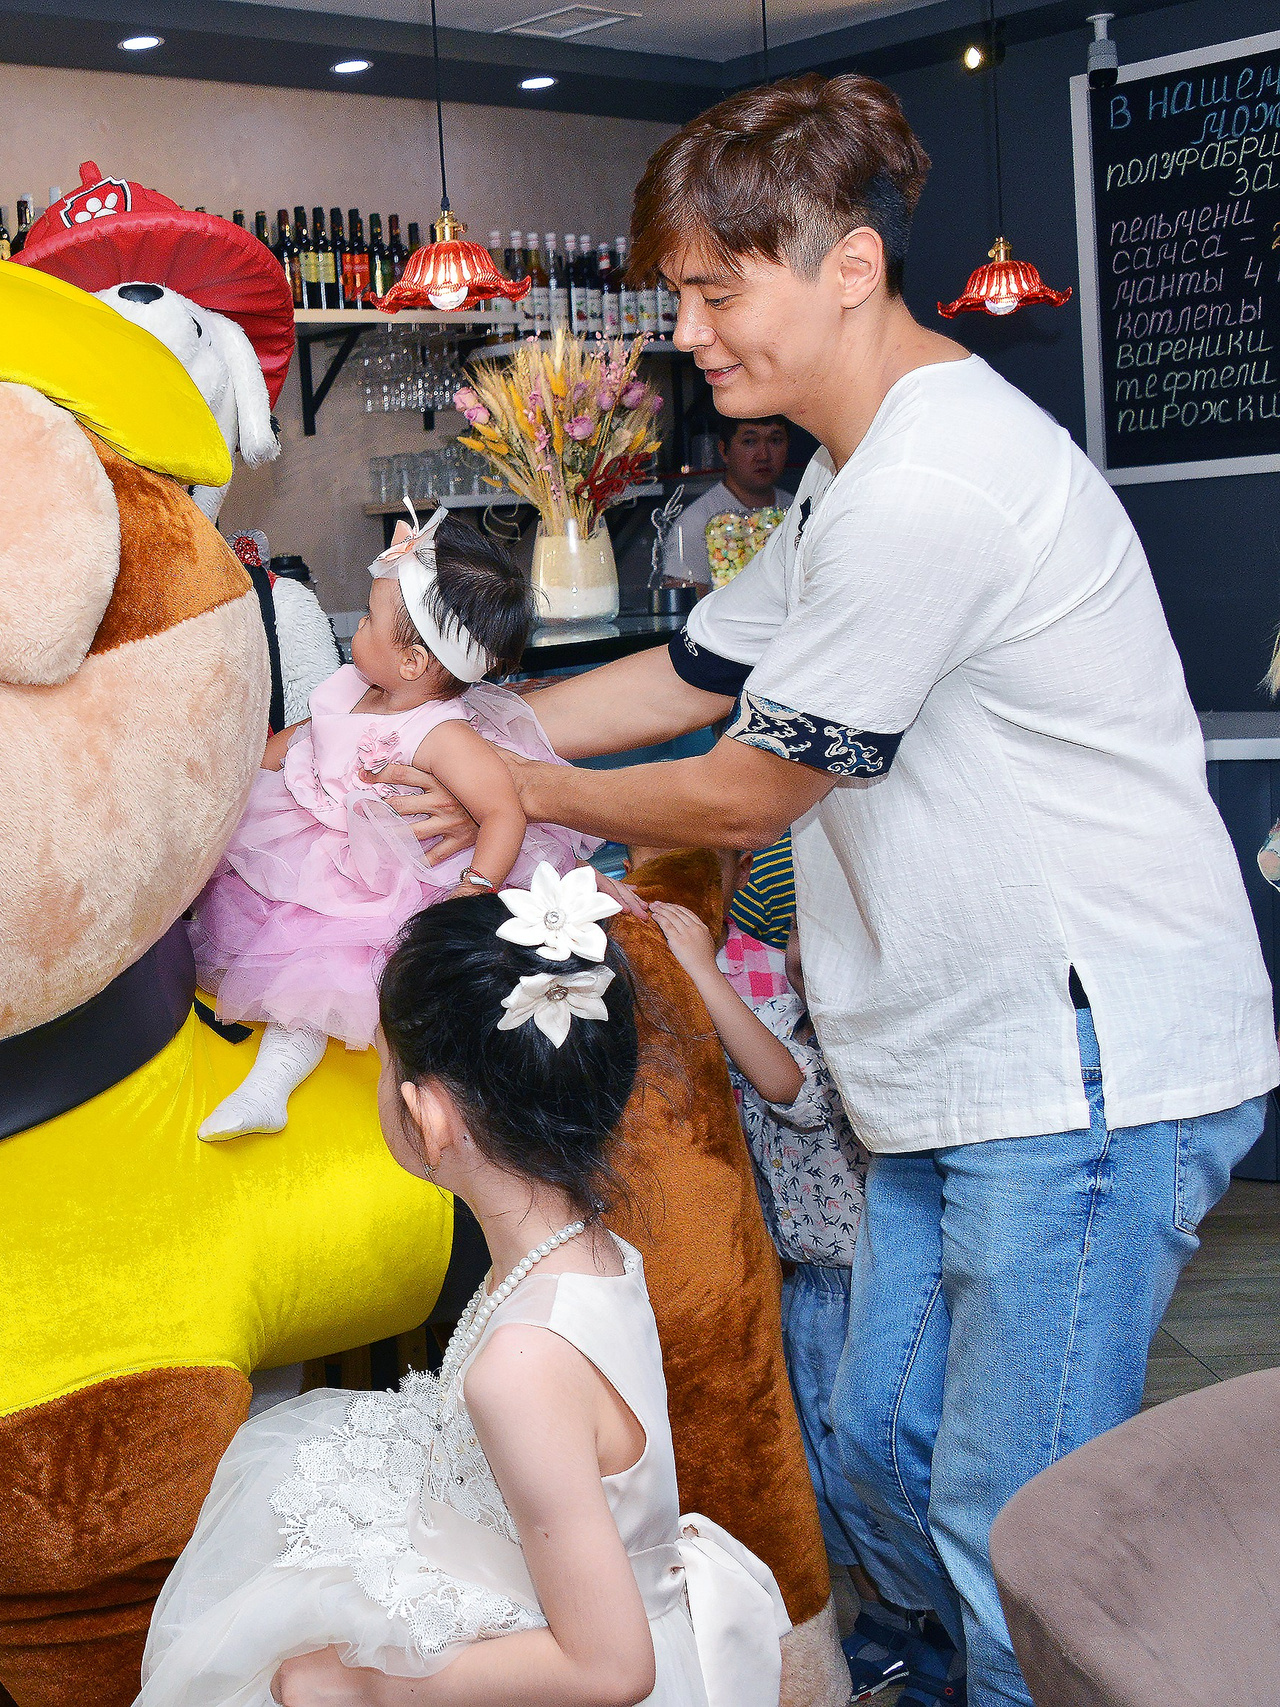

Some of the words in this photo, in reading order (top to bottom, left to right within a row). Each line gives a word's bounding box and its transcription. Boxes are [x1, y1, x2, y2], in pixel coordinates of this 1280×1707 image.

[1110, 199, 1255, 247] пельмени
[1112, 234, 1229, 275] самса
[1112, 267, 1224, 306] манты
[1116, 296, 1263, 340] котлеты
[1115, 360, 1277, 403] тефтели
[1118, 391, 1280, 434] пирожки
